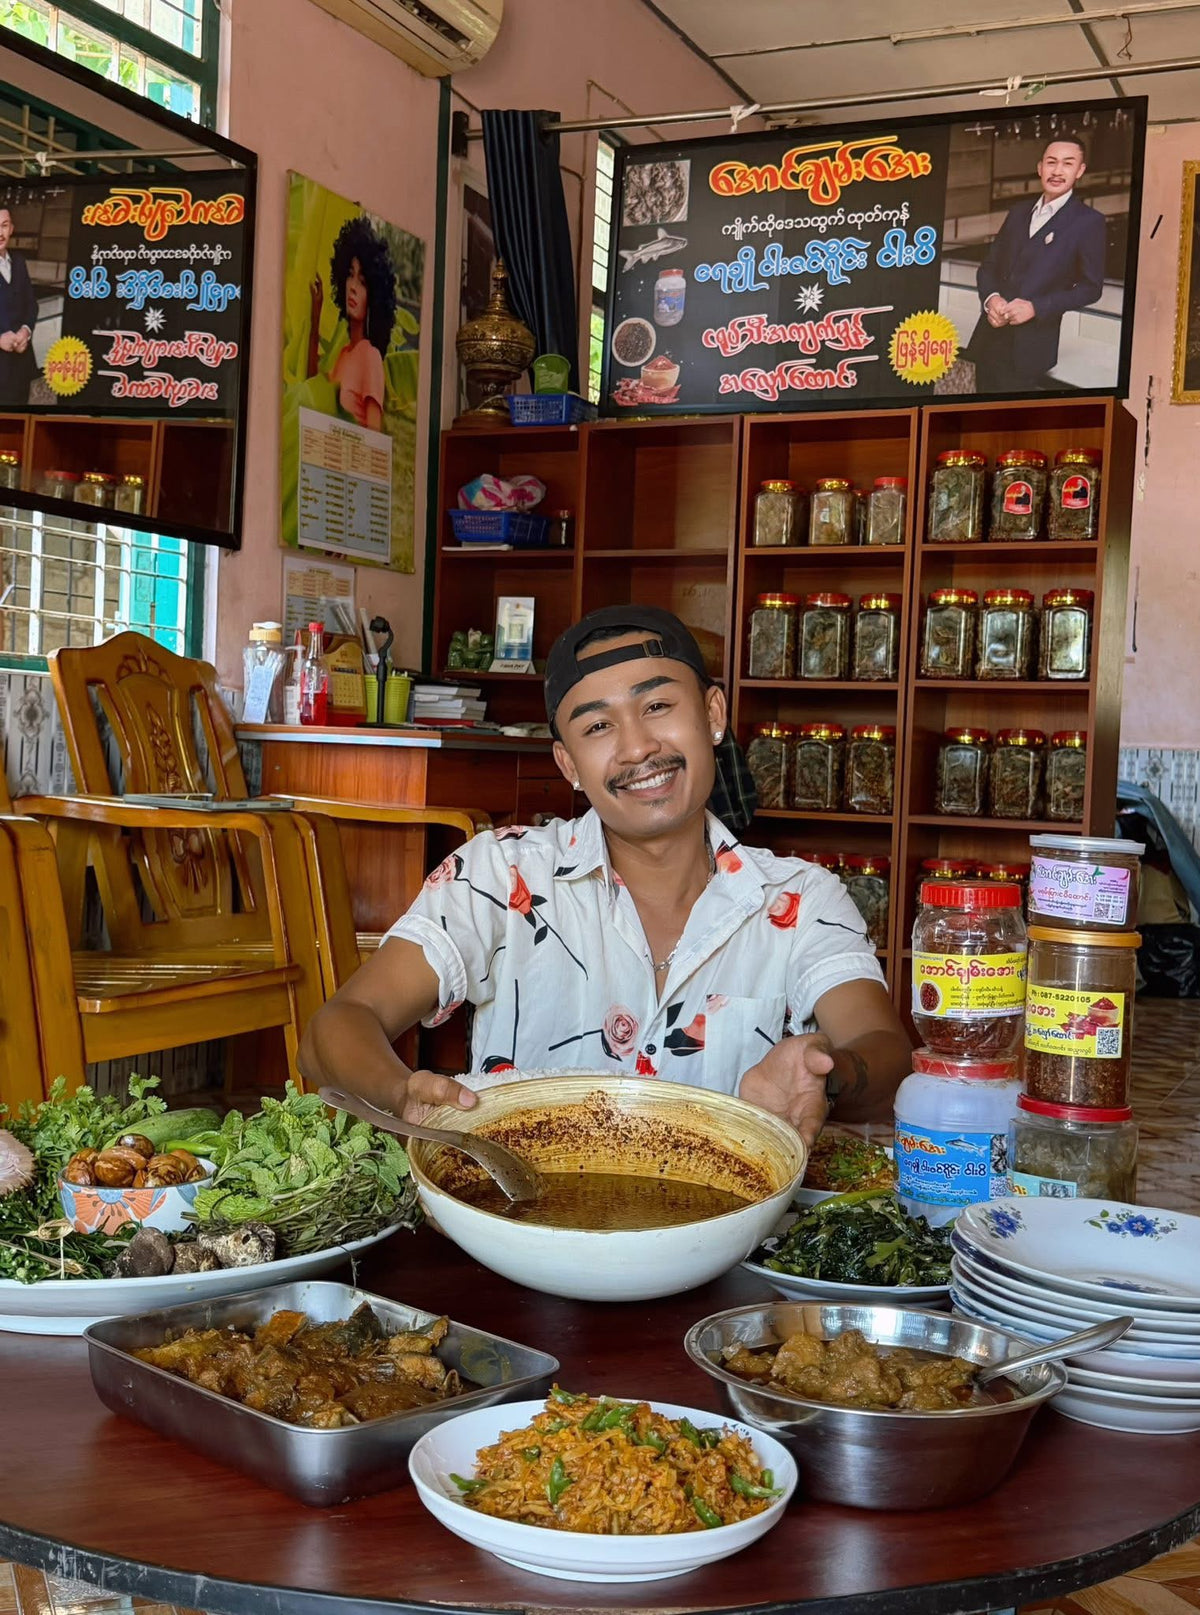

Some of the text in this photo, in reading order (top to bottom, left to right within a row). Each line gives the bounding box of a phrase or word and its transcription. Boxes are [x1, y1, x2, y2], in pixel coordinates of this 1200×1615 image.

[709, 136, 932, 205] အောင်ချမ်းအေး
[721, 201, 911, 241] ကျိုက်ထိုဒေသထွက် ထုတ်ကုန်
[694, 245, 769, 294] ရေချို
[877, 225, 938, 269] ငါးပိ
[920, 959, 1015, 985] အောင်ချမ်းအေး
